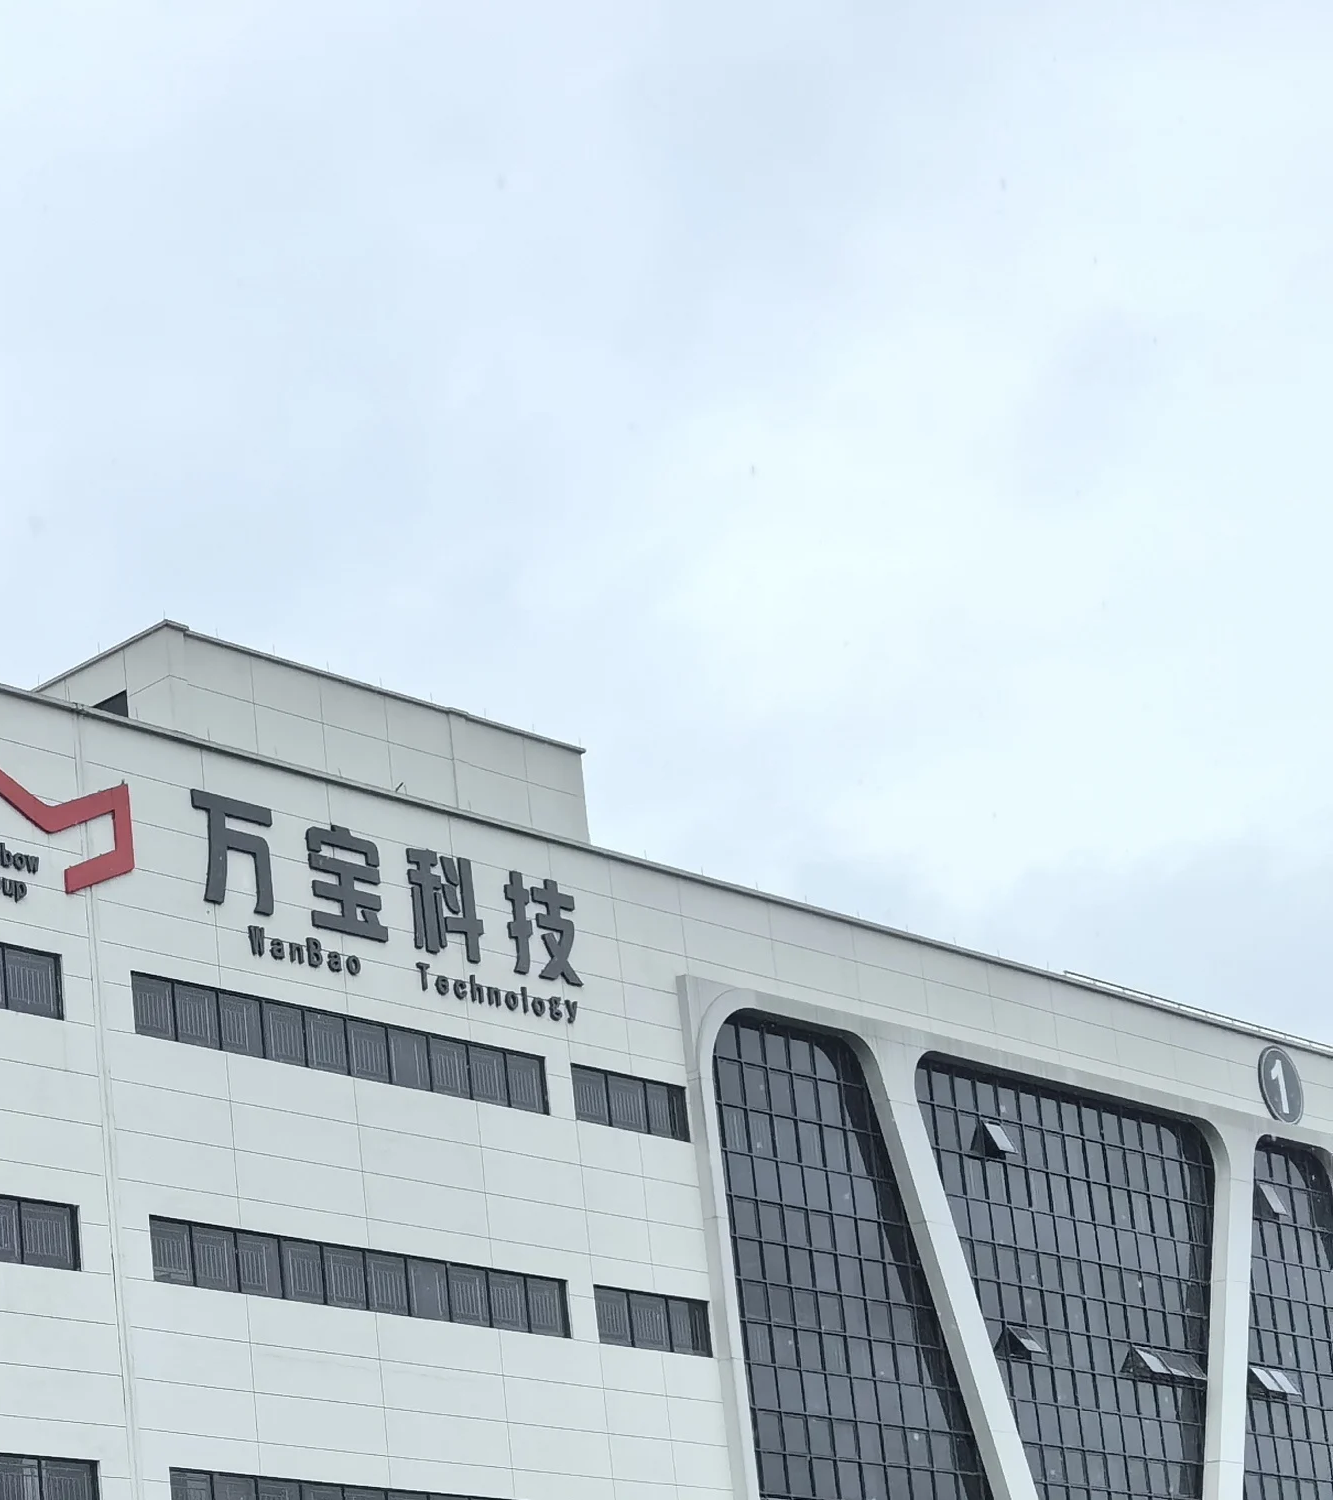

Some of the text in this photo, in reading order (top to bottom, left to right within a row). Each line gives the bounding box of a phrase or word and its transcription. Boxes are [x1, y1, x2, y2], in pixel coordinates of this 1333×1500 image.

[190, 788, 584, 987] 万宝科技
[247, 925, 579, 1024] WanBao Technology
[1270, 1059, 1290, 1114] 1
